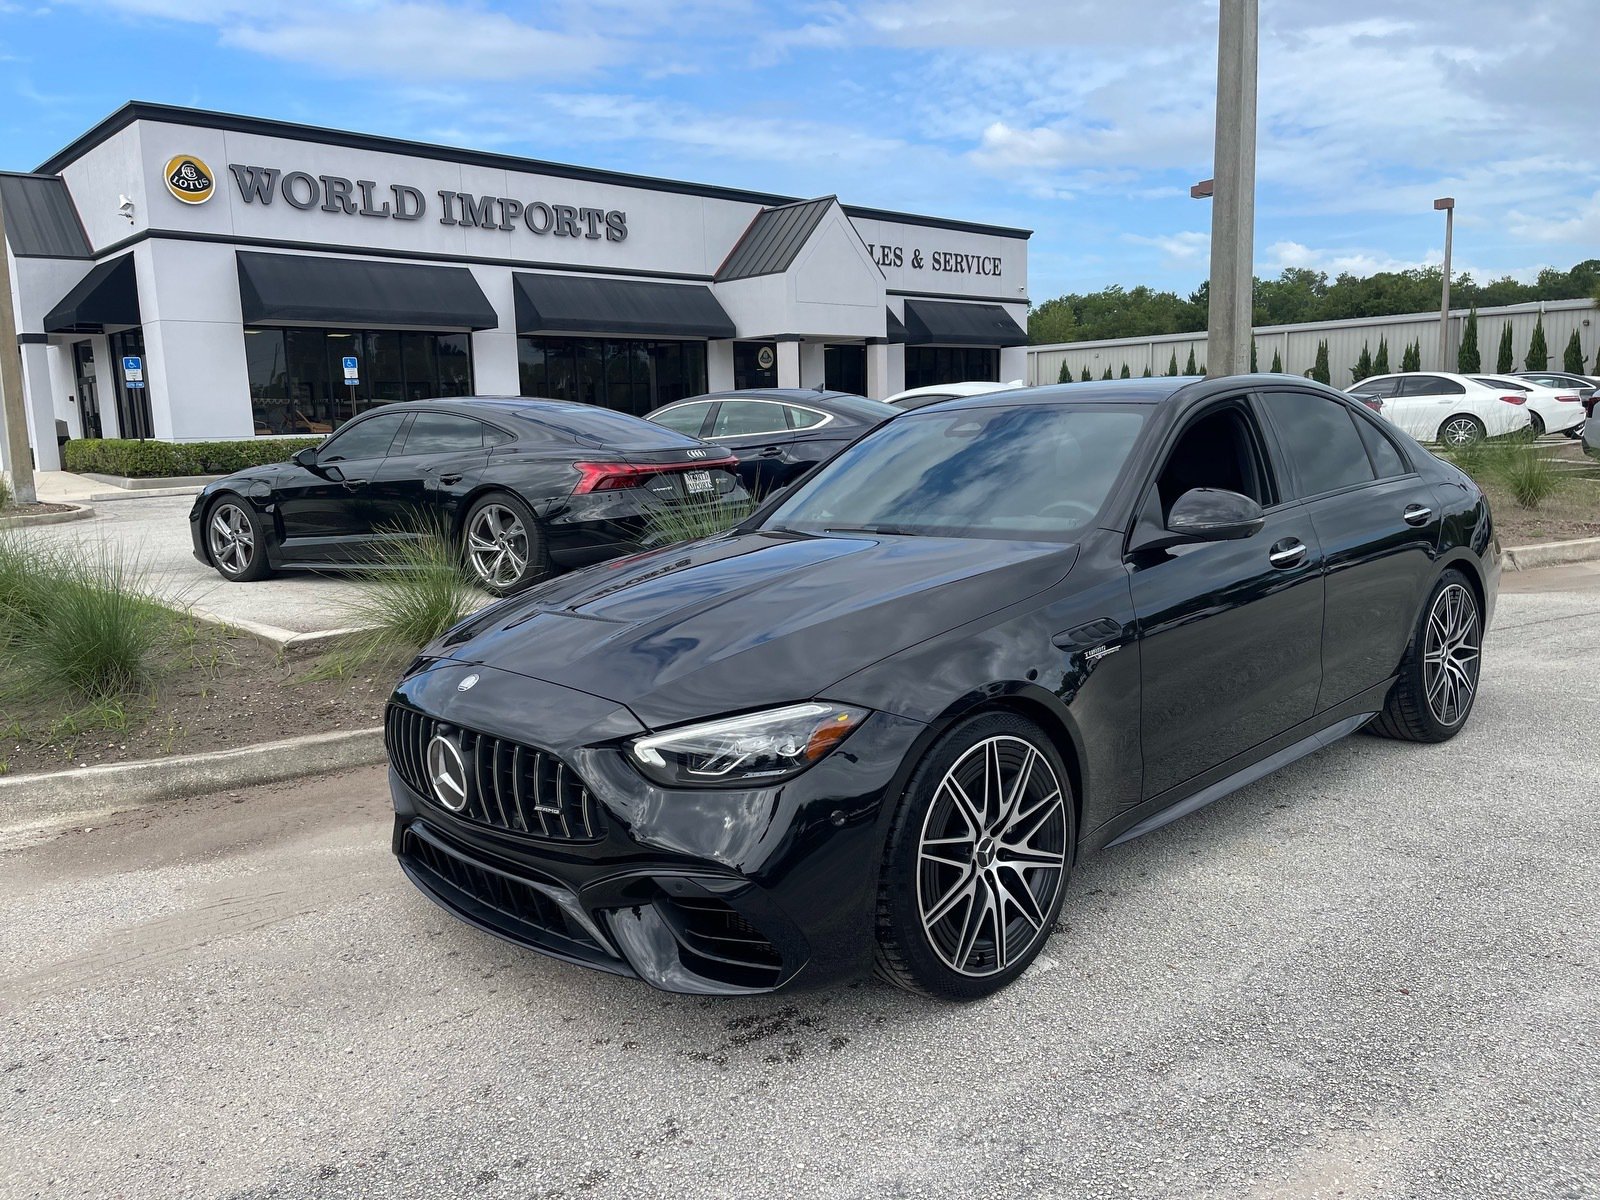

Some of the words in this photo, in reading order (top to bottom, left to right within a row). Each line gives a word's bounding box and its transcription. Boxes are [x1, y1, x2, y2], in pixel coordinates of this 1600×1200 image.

[172, 175, 209, 189] LOTUS
[228, 163, 427, 221] WORLD
[437, 190, 629, 243] IMPORTS
[911, 248, 924, 269] &
[932, 250, 1002, 277] SERVICE
